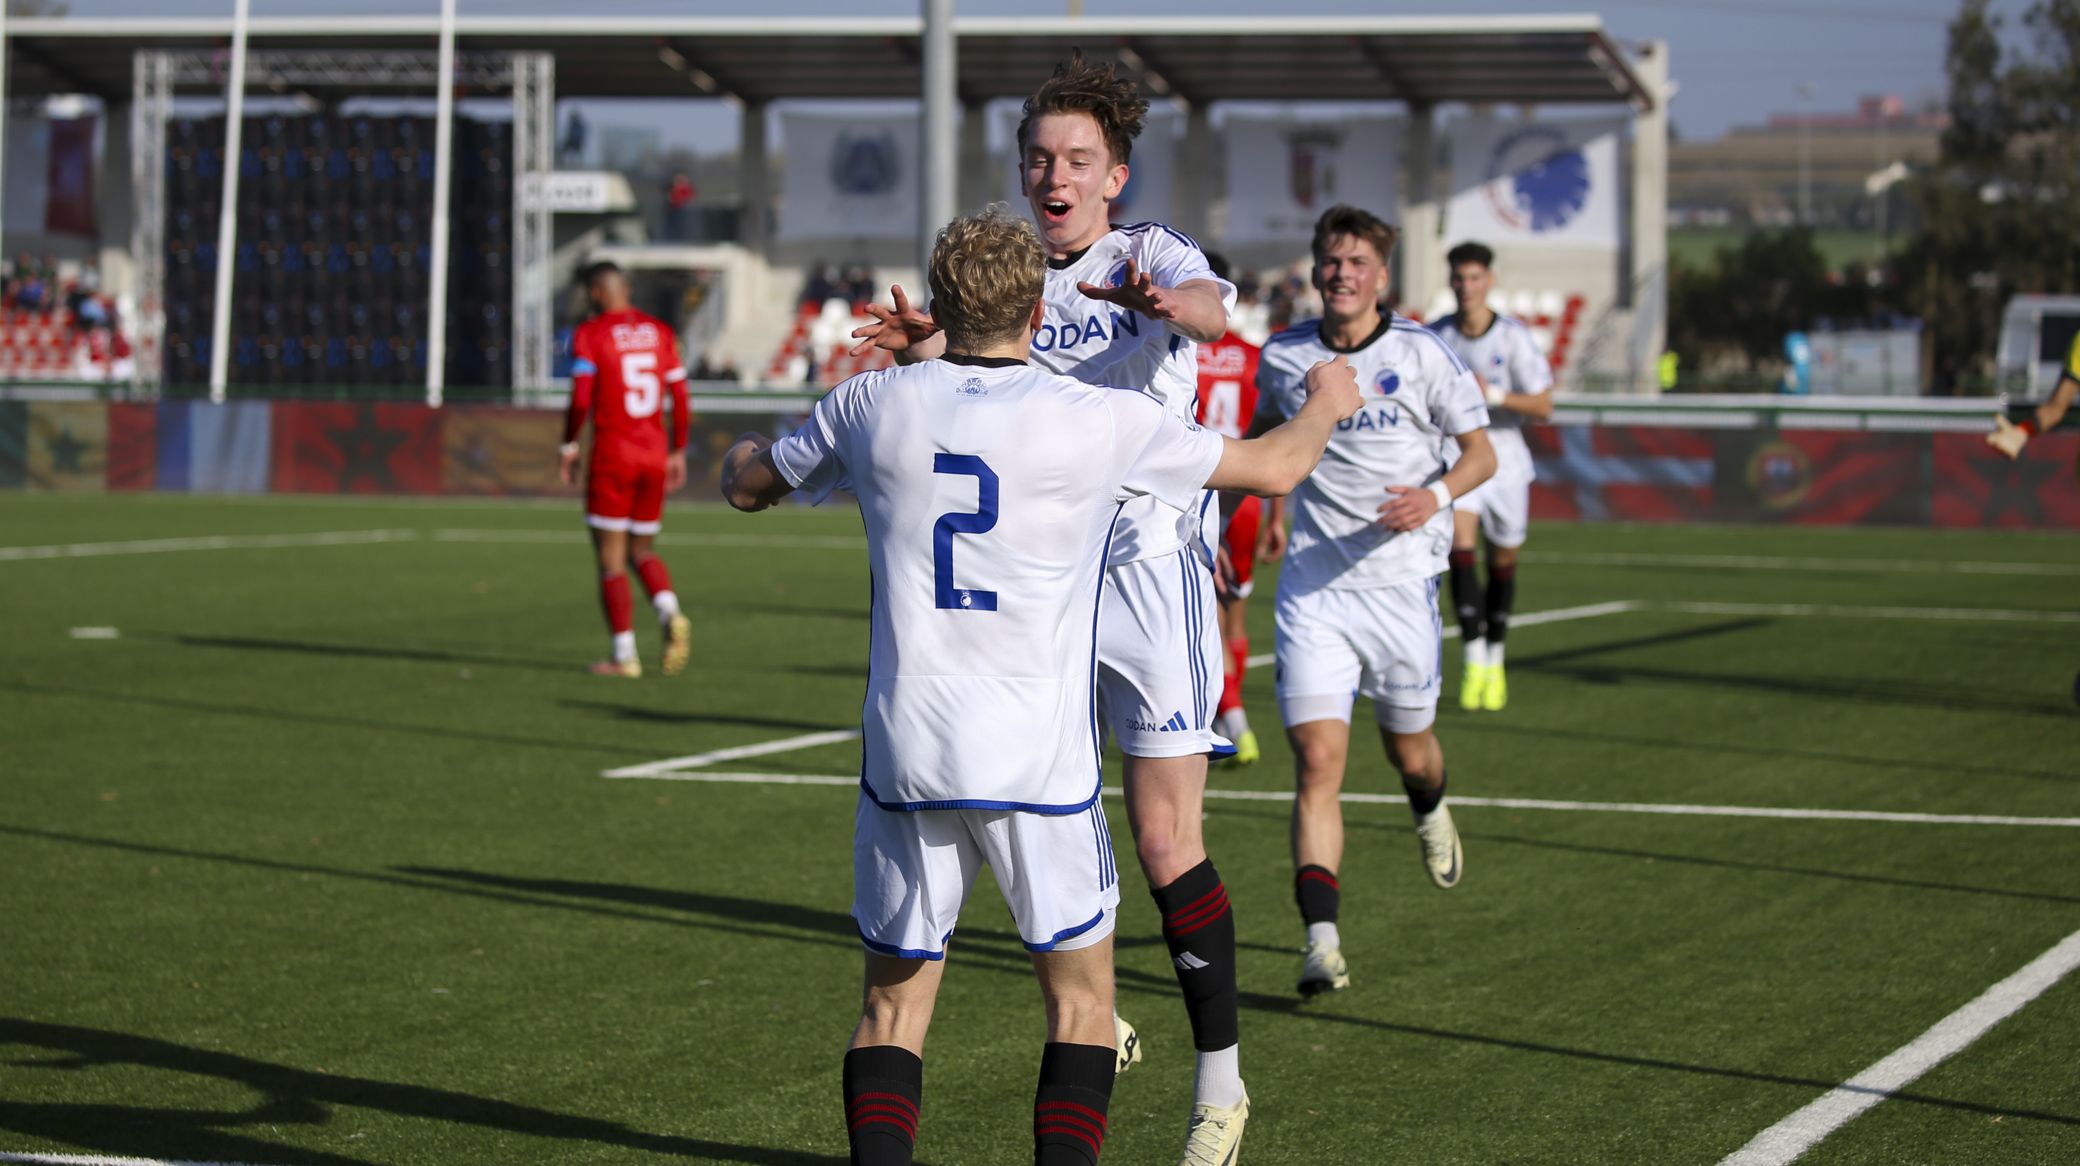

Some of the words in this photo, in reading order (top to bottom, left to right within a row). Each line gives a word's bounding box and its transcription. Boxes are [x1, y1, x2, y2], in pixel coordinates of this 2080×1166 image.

[1032, 309, 1139, 352] ODAN
[621, 351, 660, 419] 5
[1203, 380, 1241, 440] 4
[1337, 406, 1399, 431] DAN
[933, 453, 999, 611] 2
